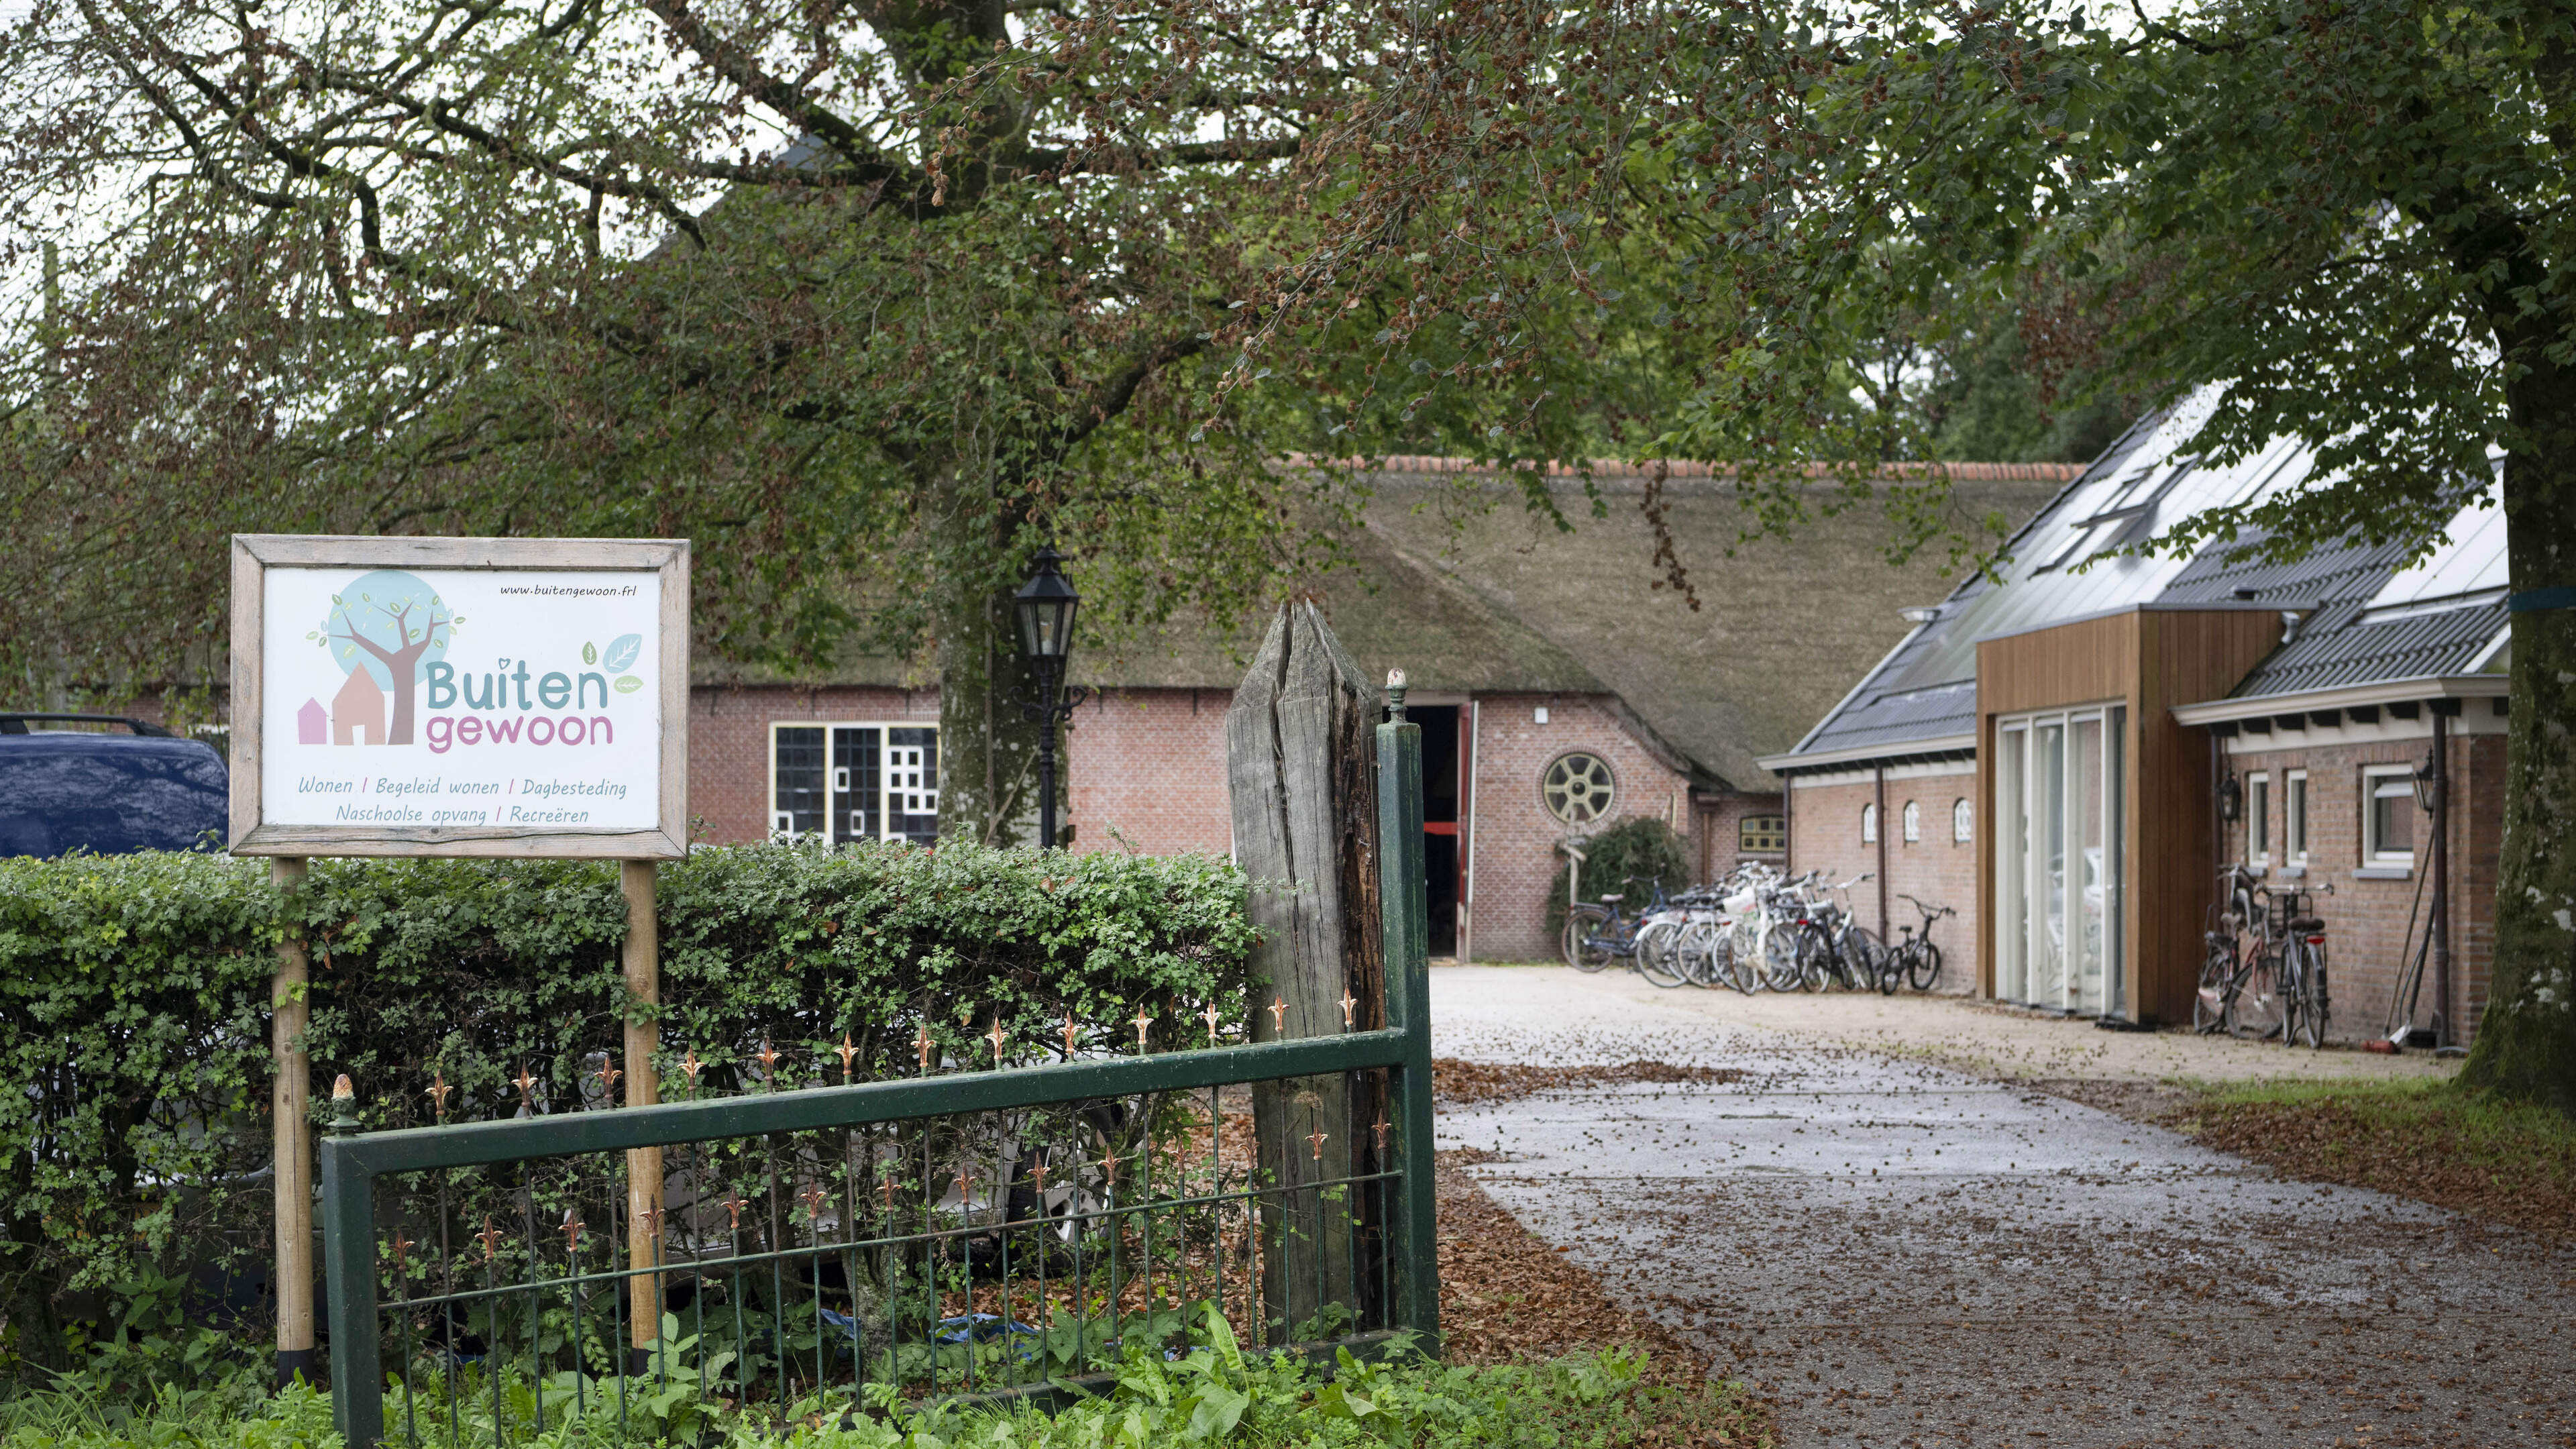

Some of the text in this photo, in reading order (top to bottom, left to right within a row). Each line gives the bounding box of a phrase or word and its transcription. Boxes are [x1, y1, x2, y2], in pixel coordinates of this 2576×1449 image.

[501, 585, 636, 598] www.buitengewoon.frl
[425, 658, 608, 710] Buiten
[426, 716, 613, 754] gewoon
[299, 776, 627, 800] Wonen Begeleid wonen Dagbesteding
[336, 804, 589, 826] Naschoolse opvang Recreëren
